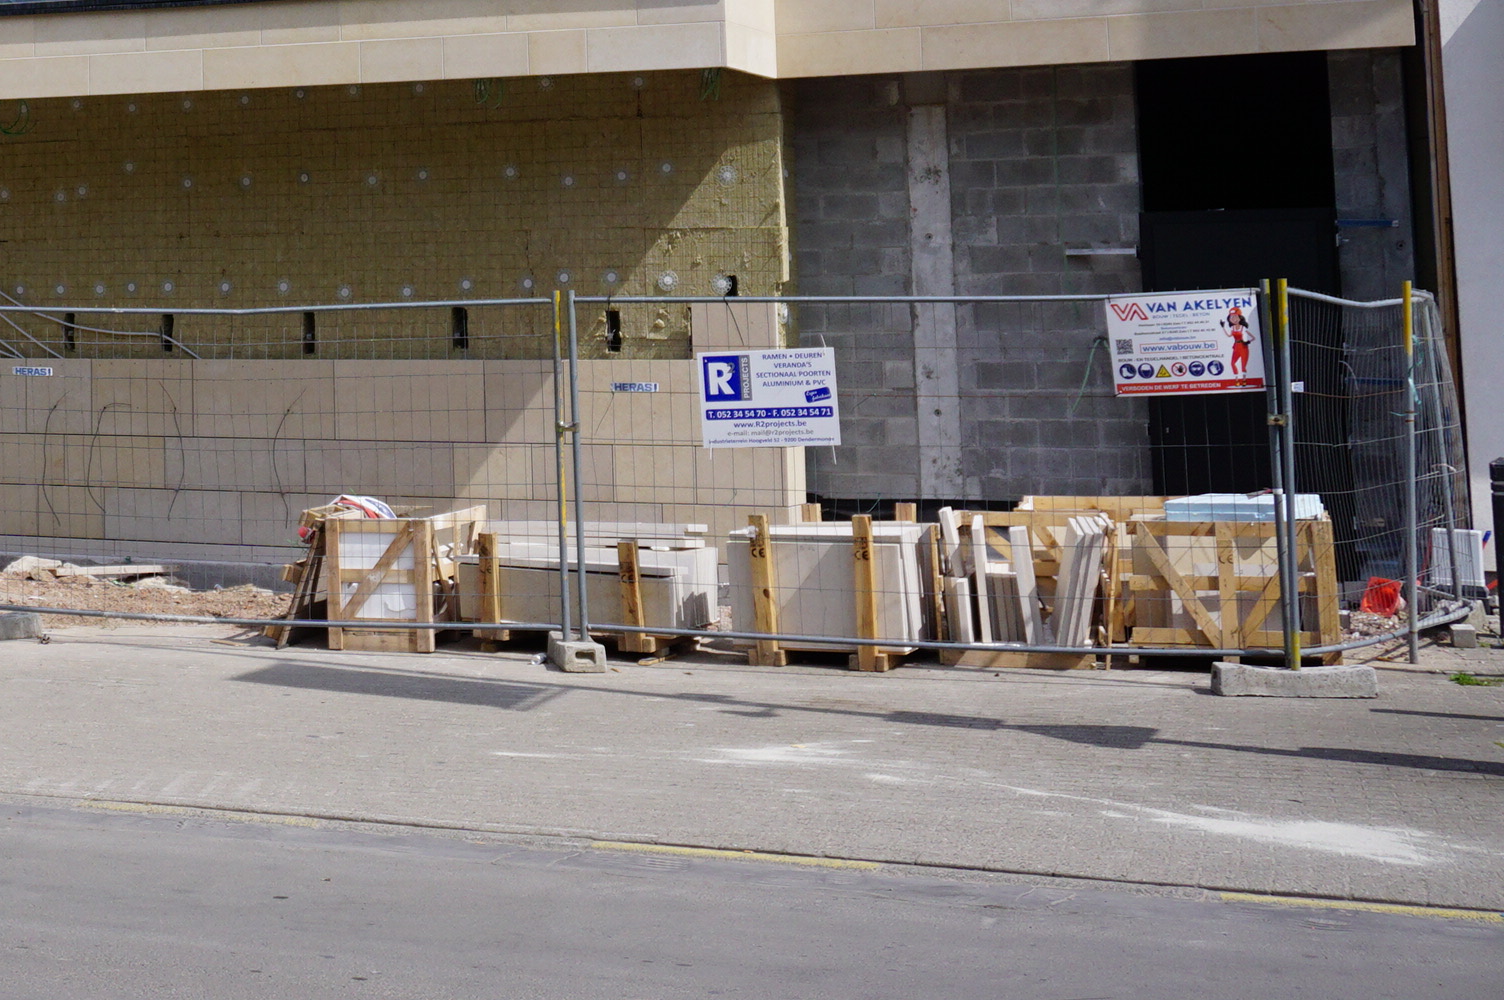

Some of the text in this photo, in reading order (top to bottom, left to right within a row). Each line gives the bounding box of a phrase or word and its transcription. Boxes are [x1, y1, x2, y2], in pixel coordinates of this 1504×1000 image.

[1146, 298, 1252, 312] VAN AKELYEN
[1142, 342, 1215, 352] www.vabouw.be
[742, 357, 750, 398] PROJECTS
[734, 420, 807, 428] www.R2projects.be
[751, 428, 814, 436] mail@r2projects.be
